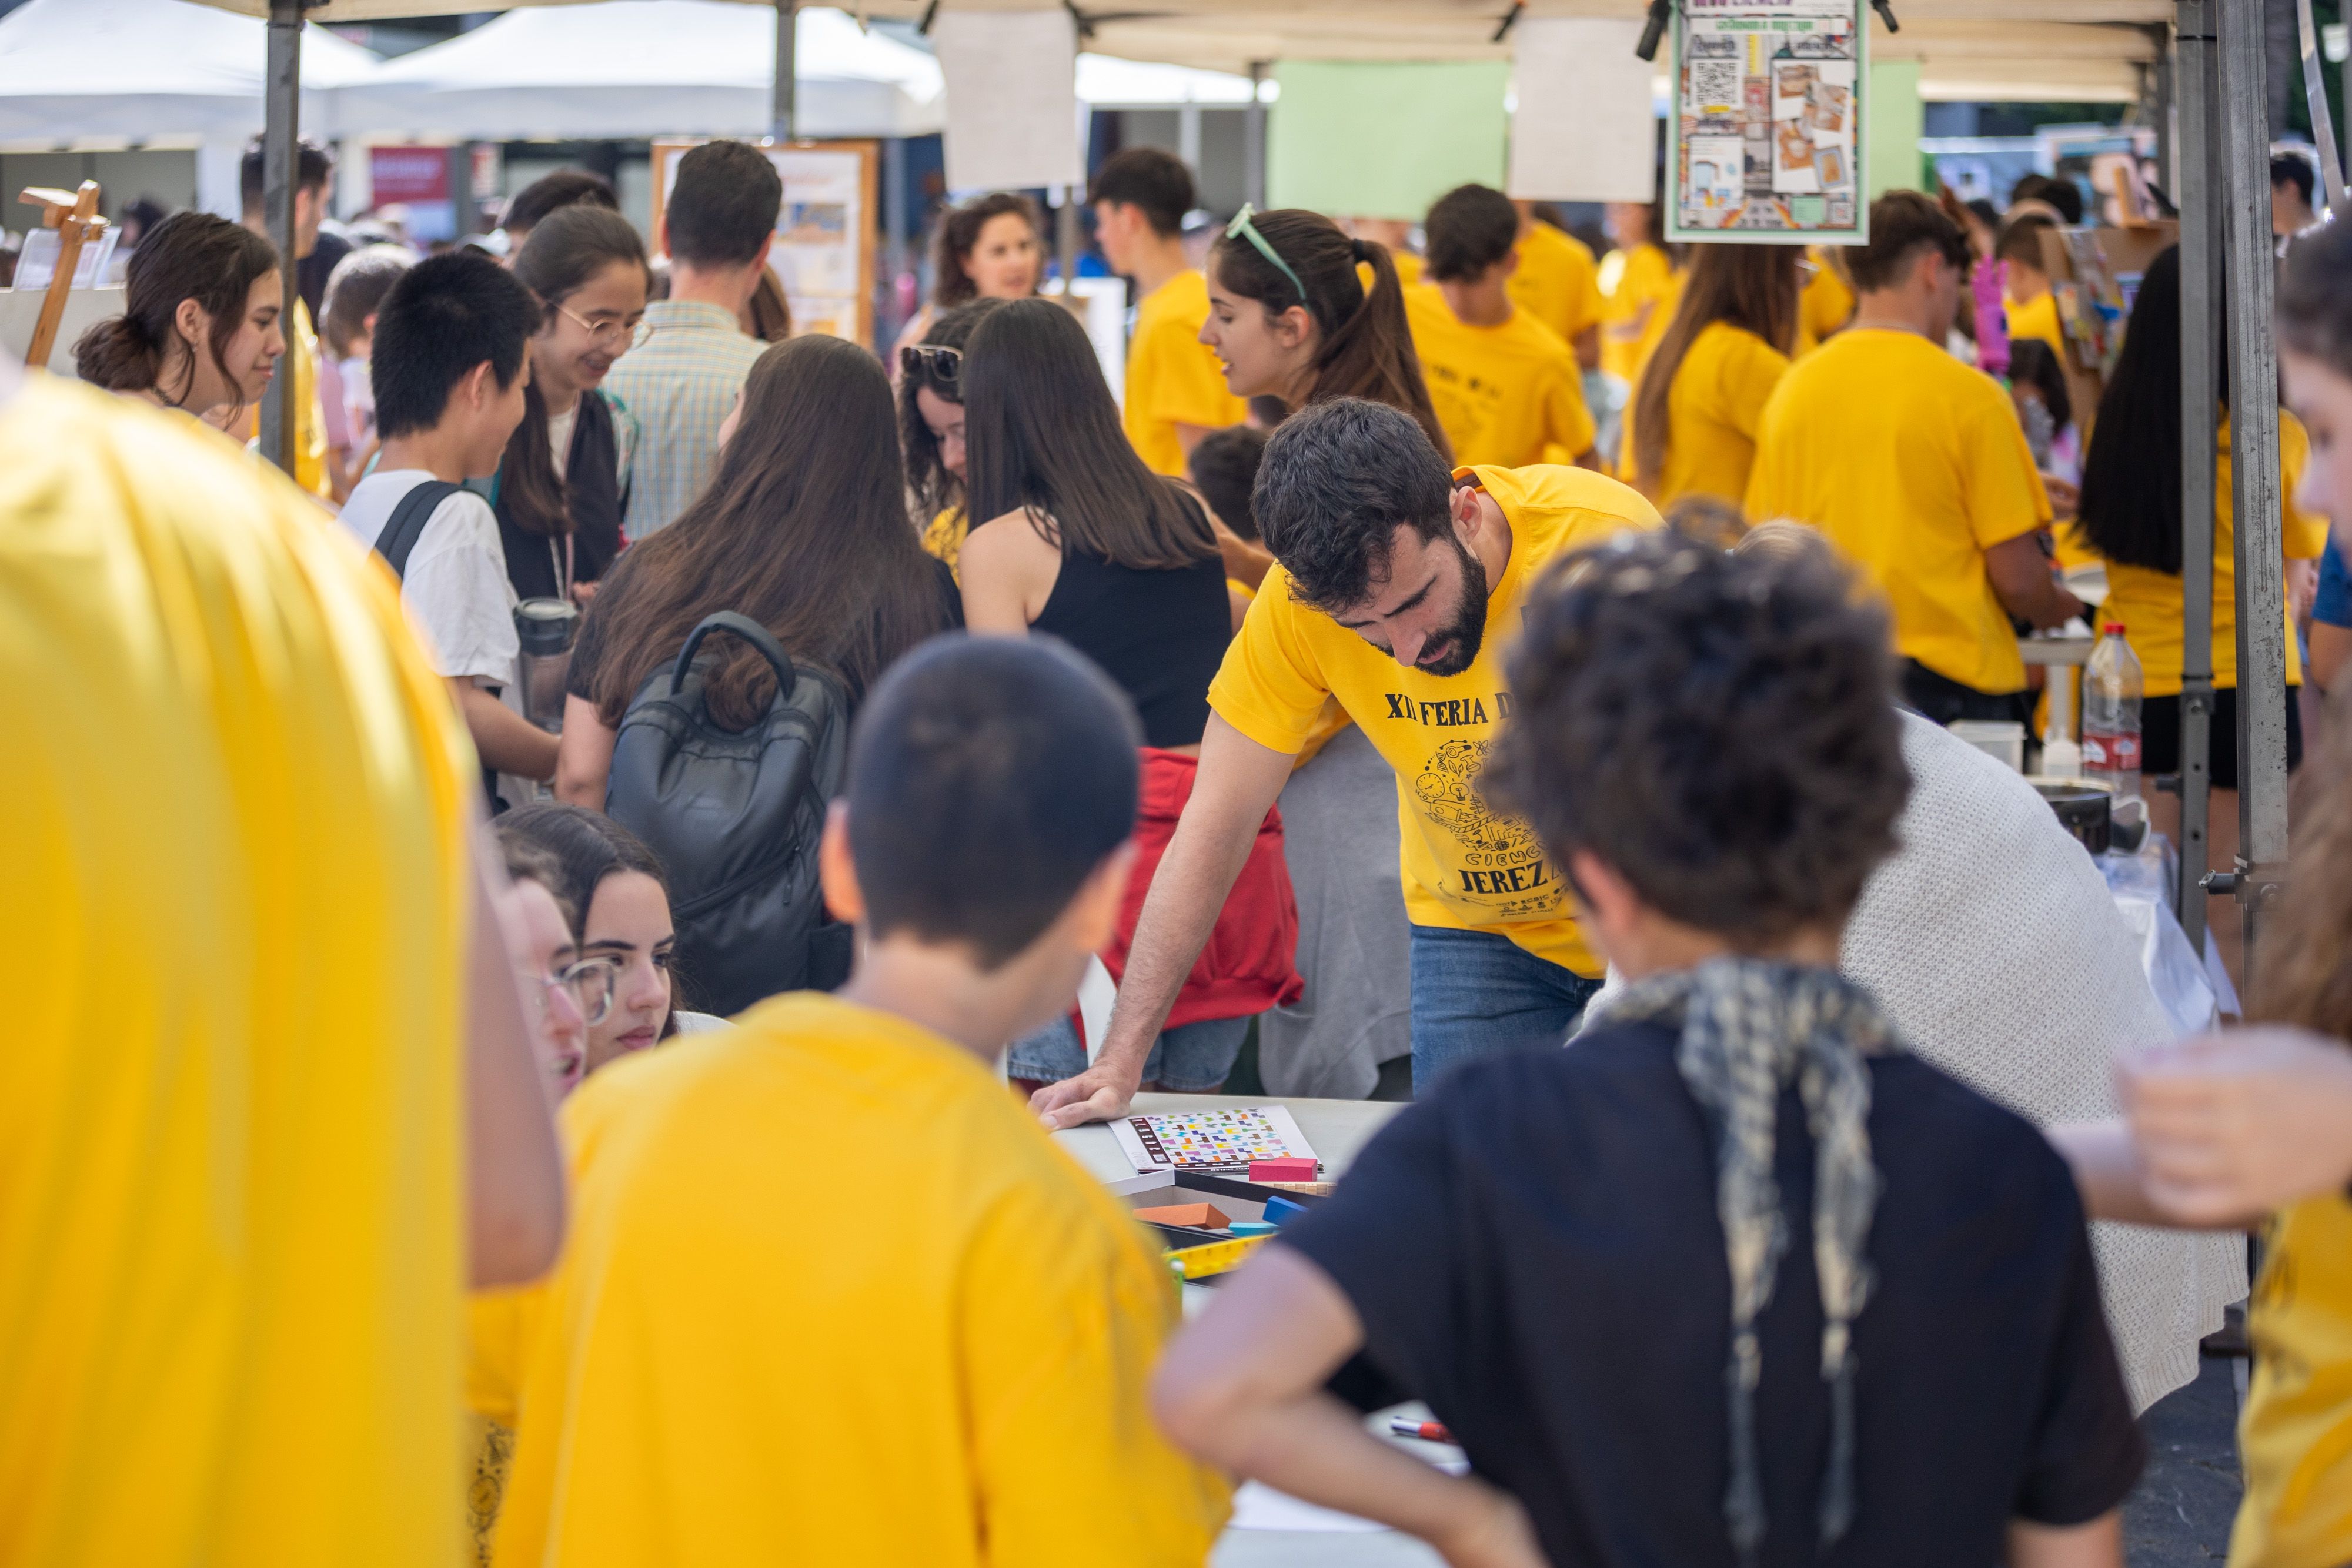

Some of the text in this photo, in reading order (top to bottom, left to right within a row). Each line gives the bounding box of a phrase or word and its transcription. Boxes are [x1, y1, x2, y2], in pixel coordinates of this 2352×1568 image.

[1419, 698, 1489, 726] FERIA
[1494, 691, 1516, 720] D
[1465, 841, 1548, 867] CIENCI
[1458, 860, 1548, 894] JEREZ
[1526, 894, 1549, 903] CSIC
